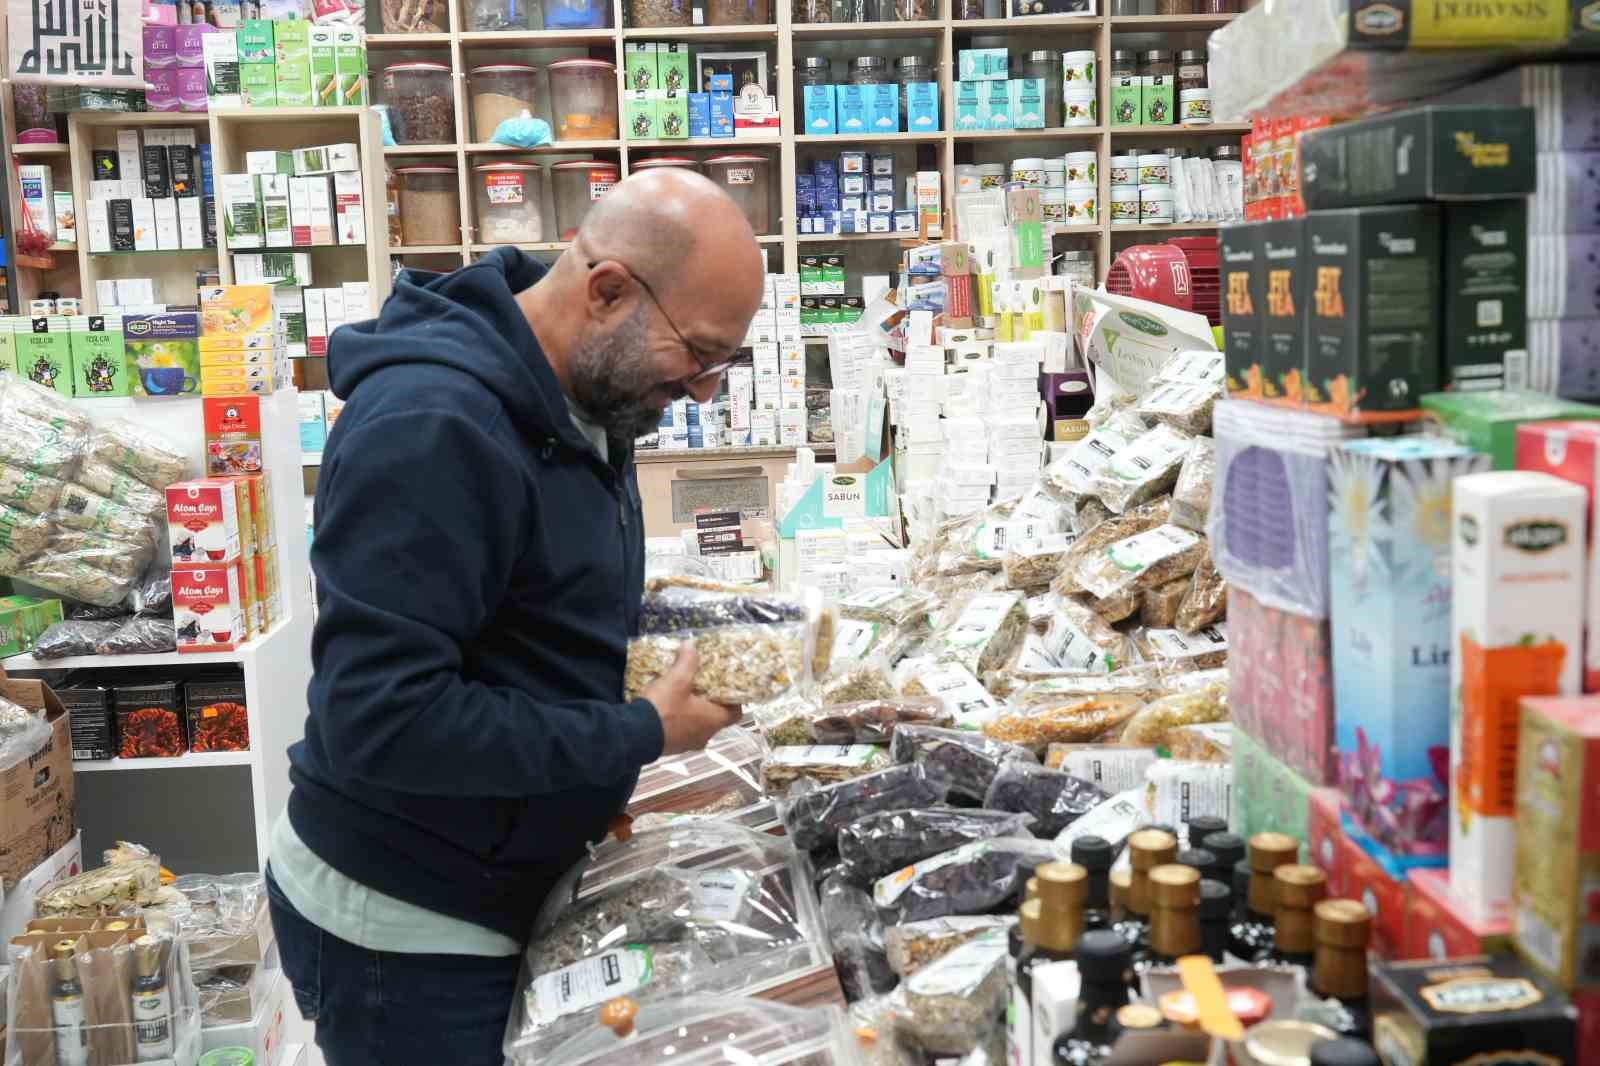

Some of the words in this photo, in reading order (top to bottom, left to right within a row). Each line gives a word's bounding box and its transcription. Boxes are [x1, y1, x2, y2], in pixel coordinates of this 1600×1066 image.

[1227, 271, 1250, 293] FIT
[1269, 270, 1291, 292] FIT
[1317, 266, 1342, 291] FIT
[1226, 293, 1254, 316] TEA
[1267, 291, 1295, 316] TEA
[1314, 290, 1345, 317] TEA
[827, 492, 861, 501] SABUN
[173, 503, 197, 513] Atom
[178, 586, 202, 595] Atom
